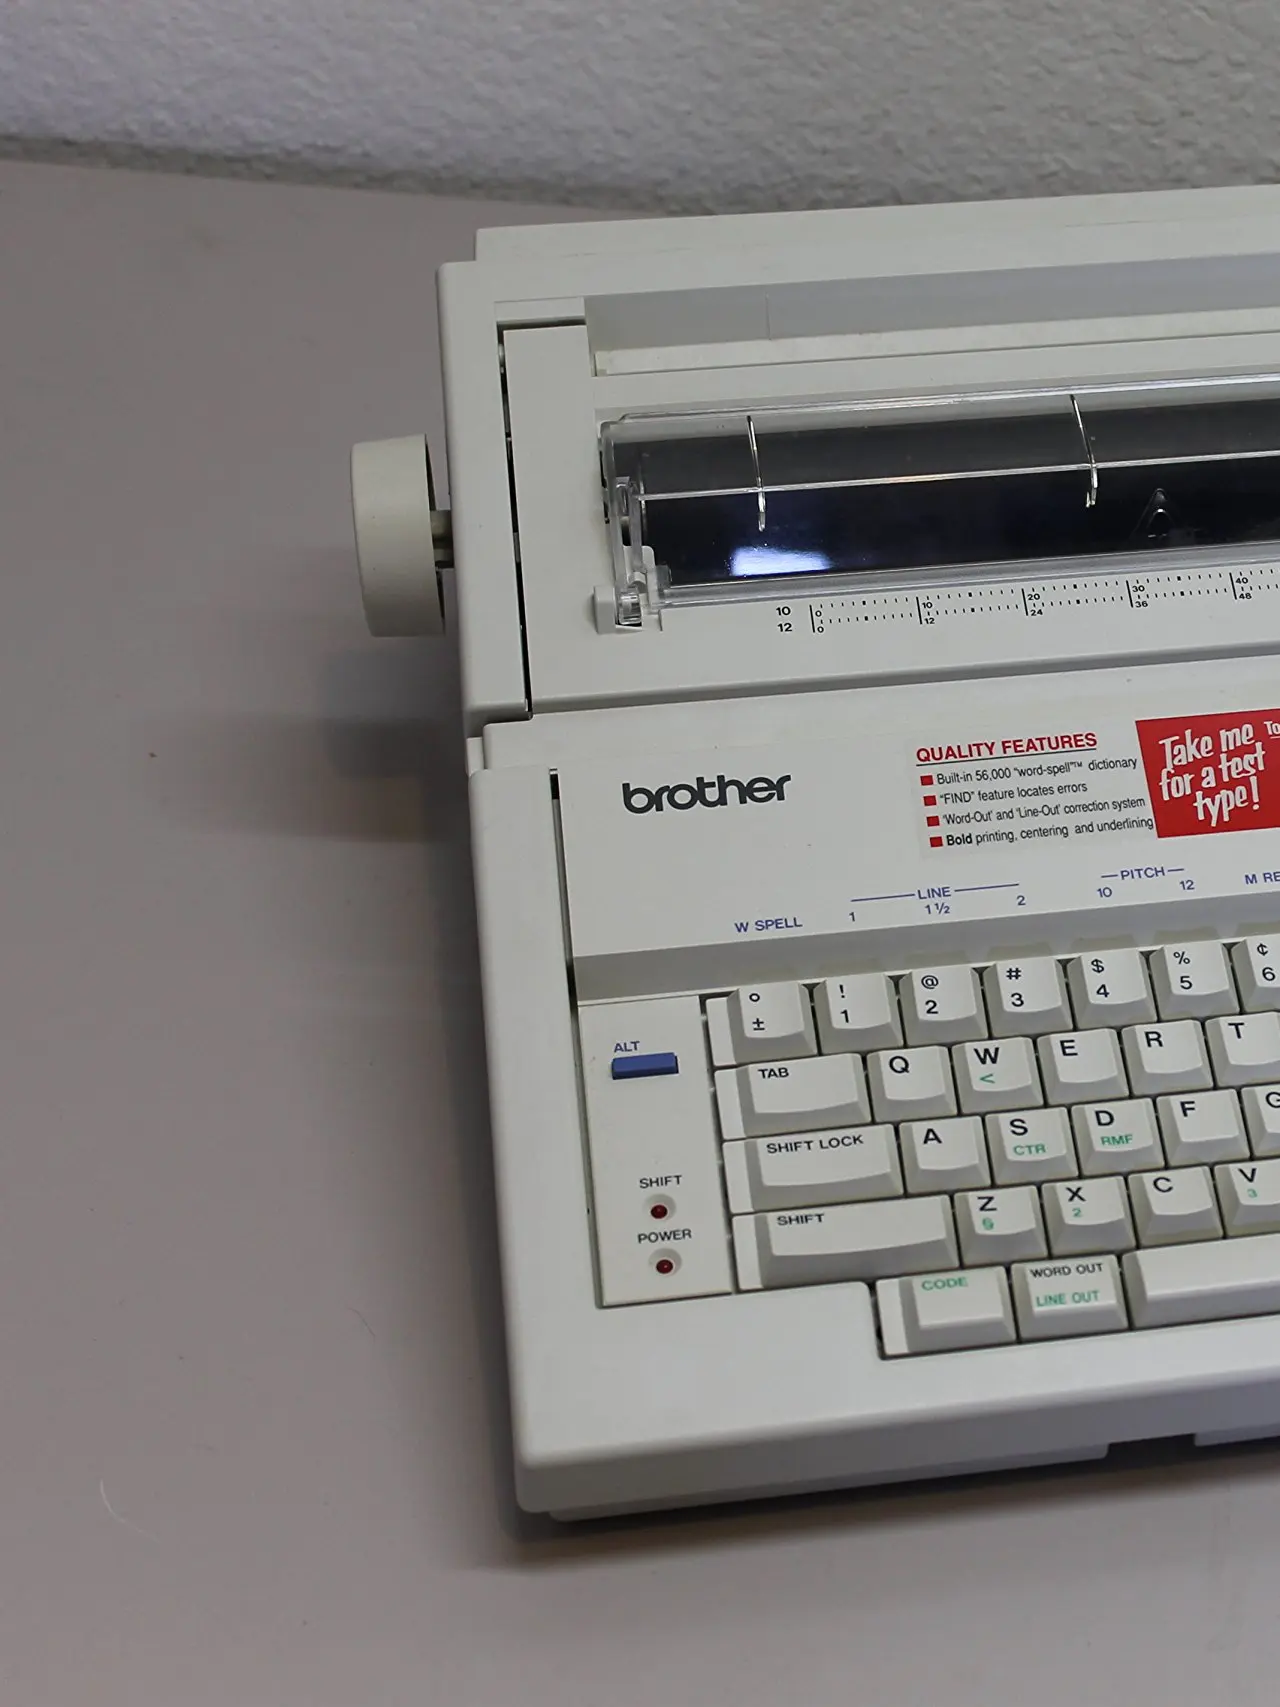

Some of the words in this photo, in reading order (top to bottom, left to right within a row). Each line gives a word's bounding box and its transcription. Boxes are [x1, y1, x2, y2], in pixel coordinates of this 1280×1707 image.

[776, 606, 791, 616] 10
[777, 623, 793, 632] 12
[916, 741, 996, 762] QUALITY
[1001, 732, 1098, 755] FEATURES
[1159, 729, 1213, 770] Take
[1219, 724, 1255, 754] me
[936, 771, 972, 785] Built-in
[975, 768, 1011, 782] 56,000
[1088, 757, 1137, 771] dictionary
[1159, 767, 1195, 801] for
[1201, 766, 1216, 788] a
[1218, 742, 1266, 783] test
[622, 774, 791, 814] brother
[978, 788, 1015, 801] feature
[1017, 784, 1055, 798] locates
[1057, 781, 1088, 793] errors
[996, 807, 1014, 820] and
[1064, 800, 1110, 814] correction
[1112, 798, 1145, 811] system
[946, 833, 972, 846] Bold
[1020, 825, 1069, 840] centering
[1075, 821, 1095, 834] and
[1097, 817, 1154, 832] underlining
[1120, 866, 1165, 881] PITCH
[1245, 873, 1258, 885] M
[917, 886, 952, 900] LINE
[1097, 887, 1113, 898] 10
[1180, 879, 1195, 891] 12
[1016, 895, 1027, 906] 2
[734, 922, 749, 933] W
[755, 917, 803, 931] SPELL
[1262, 967, 1276, 981] 6
[1096, 984, 1110, 998] 4
[925, 1000, 939, 1014] 2
[613, 1041, 641, 1053] ALT
[1144, 1030, 1164, 1048] R
[973, 1047, 1000, 1065] W
[889, 1055, 910, 1074] Q
[758, 1067, 789, 1079] TAB
[1094, 1110, 1115, 1127] D
[1009, 1119, 1029, 1136] S
[766, 1140, 813, 1155] SHIFT
[819, 1134, 864, 1150] LOCK
[922, 1128, 942, 1145] A
[1099, 1134, 1134, 1146] RMF
[1013, 1143, 1047, 1156] CTR
[639, 1175, 682, 1189] SHIFT
[1237, 1167, 1257, 1183] V
[1065, 1186, 1087, 1202] X
[637, 1228, 693, 1244] POWER
[1030, 1265, 1072, 1279] WORD
[1076, 1263, 1103, 1276] OUT
[922, 1277, 968, 1291] CODE
[1035, 1294, 1067, 1307] LINE
[1071, 1290, 1100, 1304] OUT
